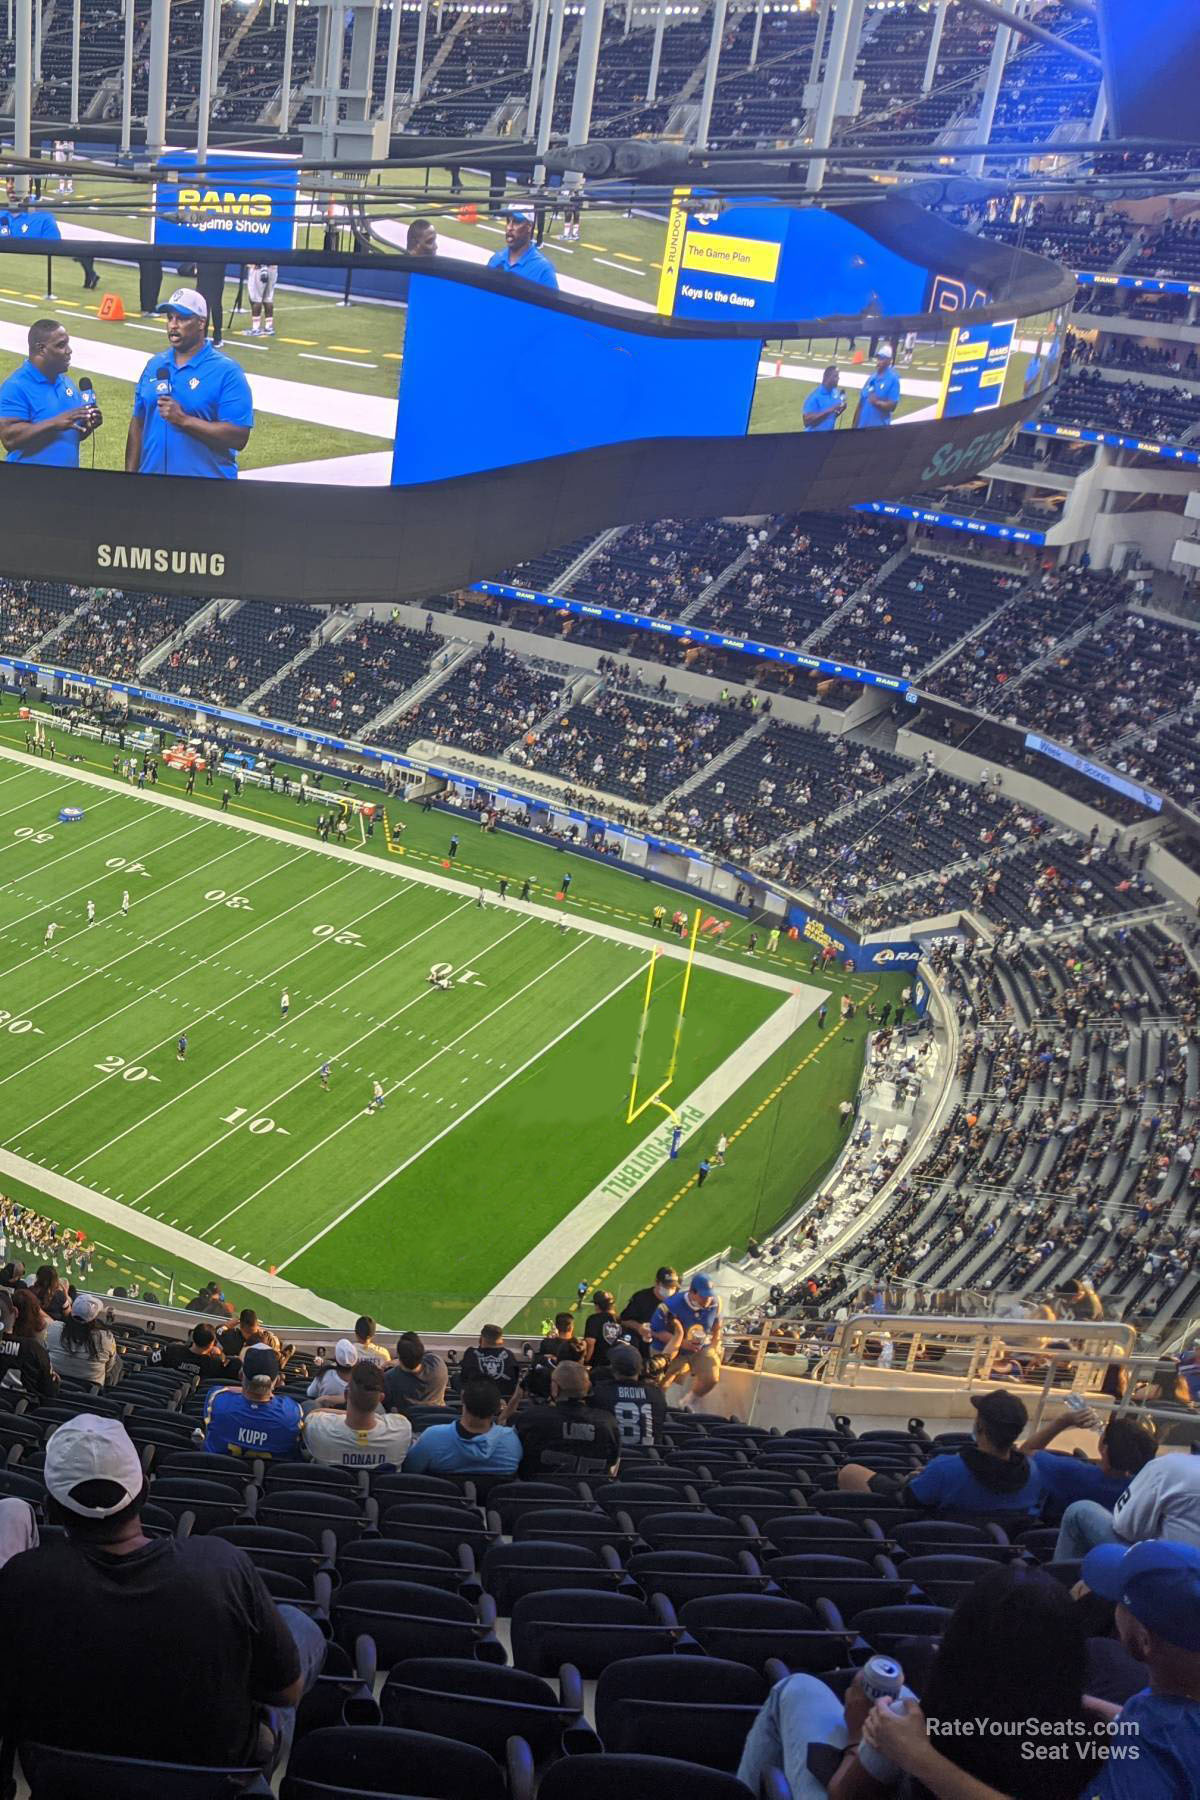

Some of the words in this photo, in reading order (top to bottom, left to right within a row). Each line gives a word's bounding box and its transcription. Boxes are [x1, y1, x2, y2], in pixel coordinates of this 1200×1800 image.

[178, 189, 273, 217] RAMS
[236, 219, 271, 235] Show
[669, 209, 682, 262] RUNDOW
[689, 245, 704, 257] The
[705, 248, 730, 260] Game
[732, 251, 751, 264] Plan
[681, 285, 703, 300] Keys
[704, 289, 713, 300] to
[714, 290, 728, 303] the
[729, 293, 756, 308] Game
[97, 544, 225, 577] SAMSUNG
[13, 827, 55, 845] 50
[105, 856, 148, 875] 40
[203, 889, 249, 910] 30
[311, 924, 363, 947] 20
[94, 1055, 150, 1083] 20
[220, 1105, 278, 1135] 10
[618, 1386, 647, 1400] BROWN
[613, 1401, 655, 1446] 81
[238, 1427, 268, 1446] KUPP
[342, 1452, 387, 1467] DONALD
